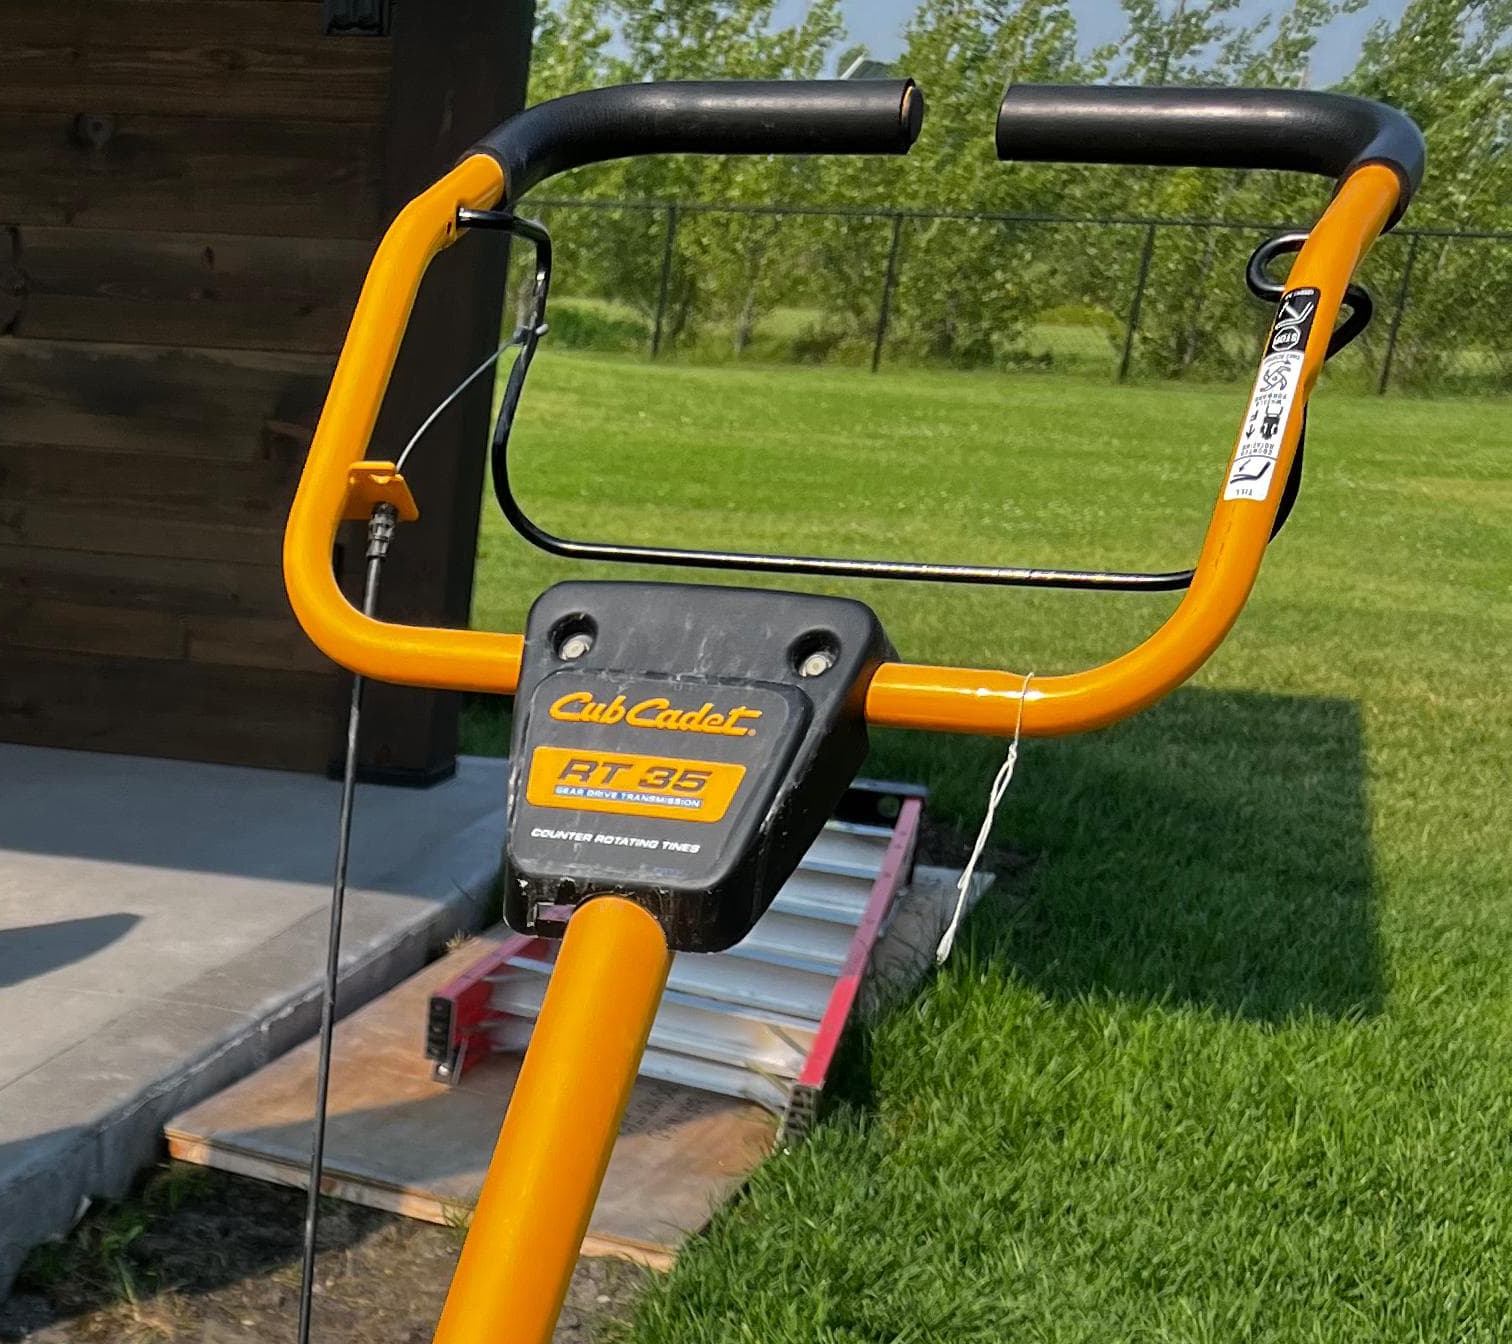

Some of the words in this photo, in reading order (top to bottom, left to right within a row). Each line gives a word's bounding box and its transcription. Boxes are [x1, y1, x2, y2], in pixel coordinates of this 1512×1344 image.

[548, 691, 627, 725] Cub
[625, 697, 763, 737] Cadet
[557, 758, 633, 785] RT
[639, 766, 713, 793] 35
[555, 786, 585, 796] GEAR
[587, 788, 619, 800] DRIVE
[621, 792, 702, 808] TRANSMISSION
[531, 827, 593, 843] COUNTER
[594, 834, 659, 850] ROTATING
[662, 840, 701, 854] TINES
